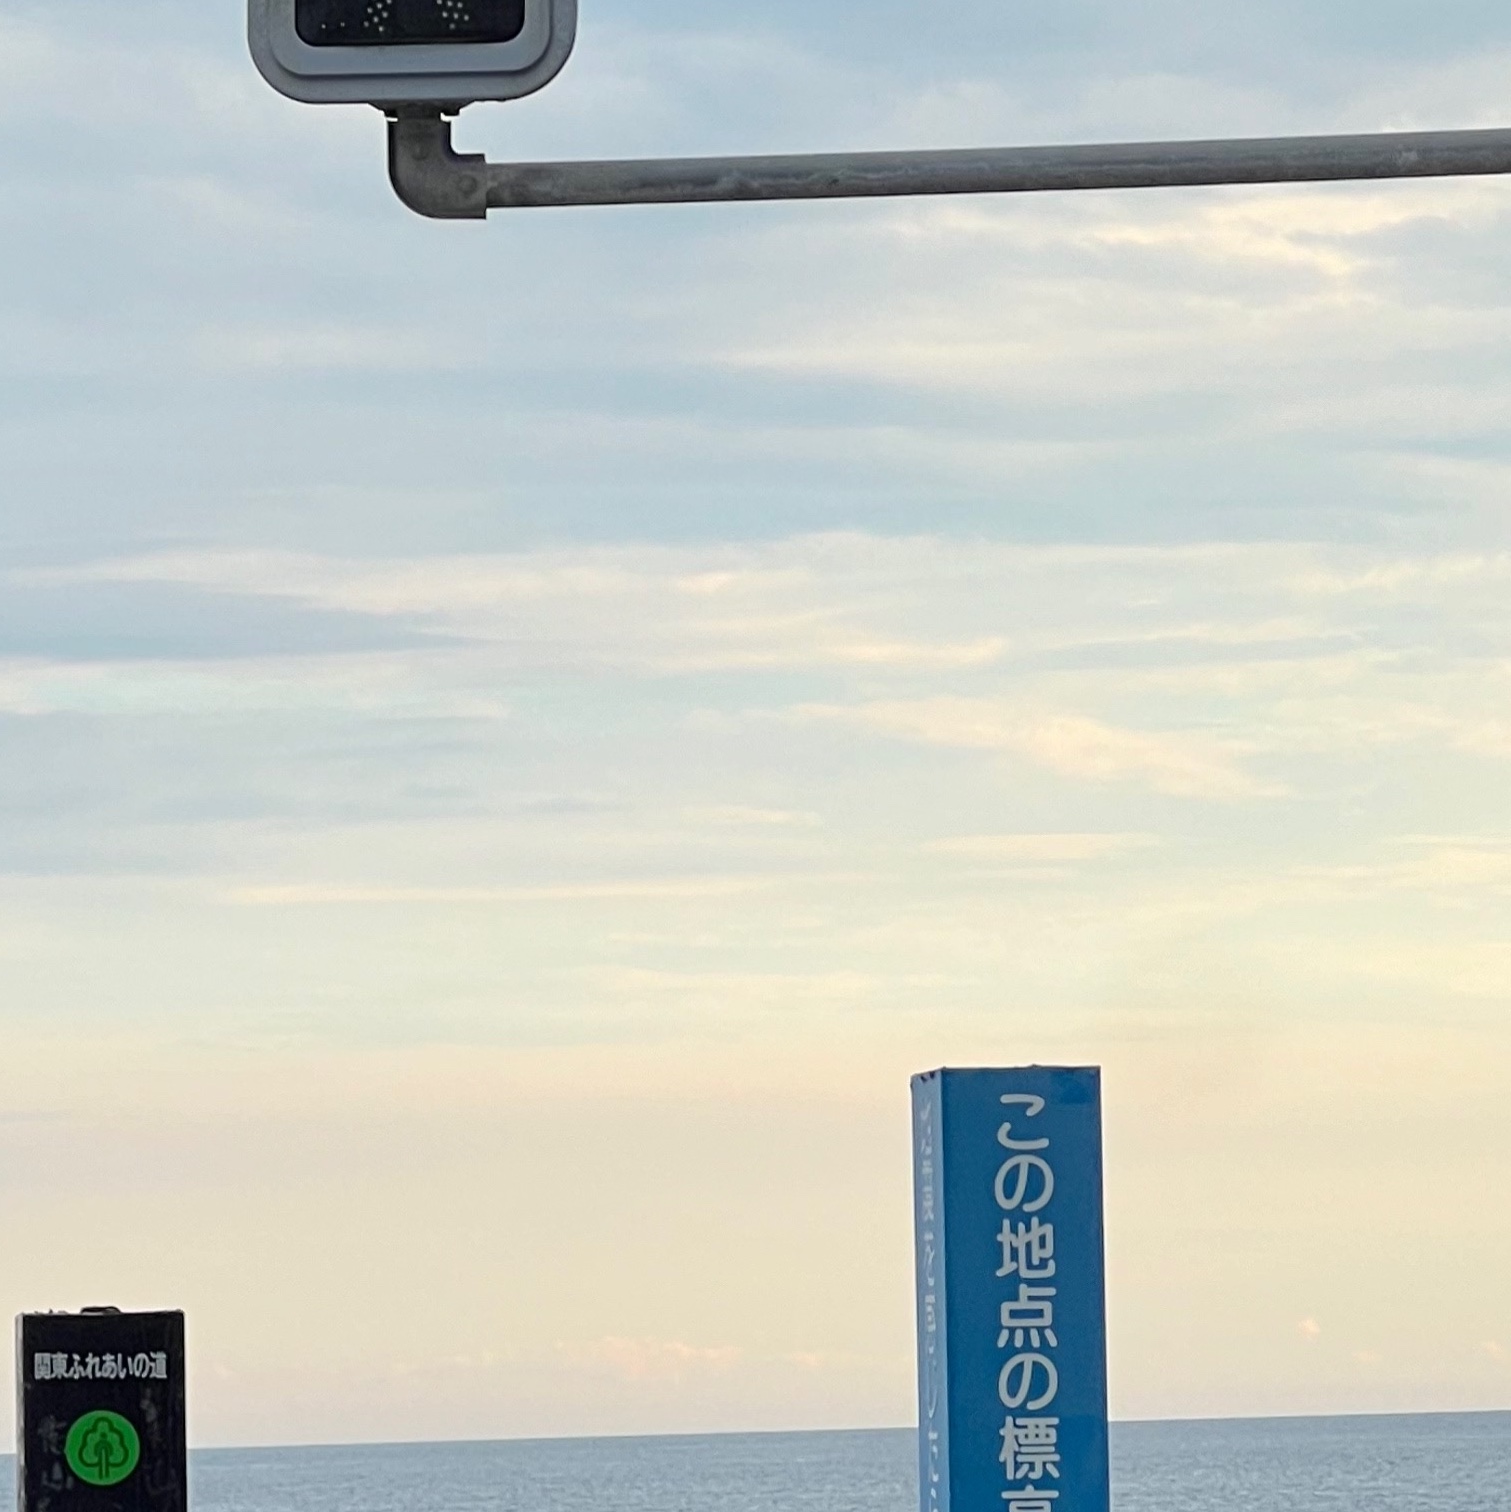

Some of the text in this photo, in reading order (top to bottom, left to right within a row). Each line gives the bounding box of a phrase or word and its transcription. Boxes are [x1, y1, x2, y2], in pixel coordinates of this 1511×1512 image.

[34, 1351, 168, 1380] 関東ふれあいの道
